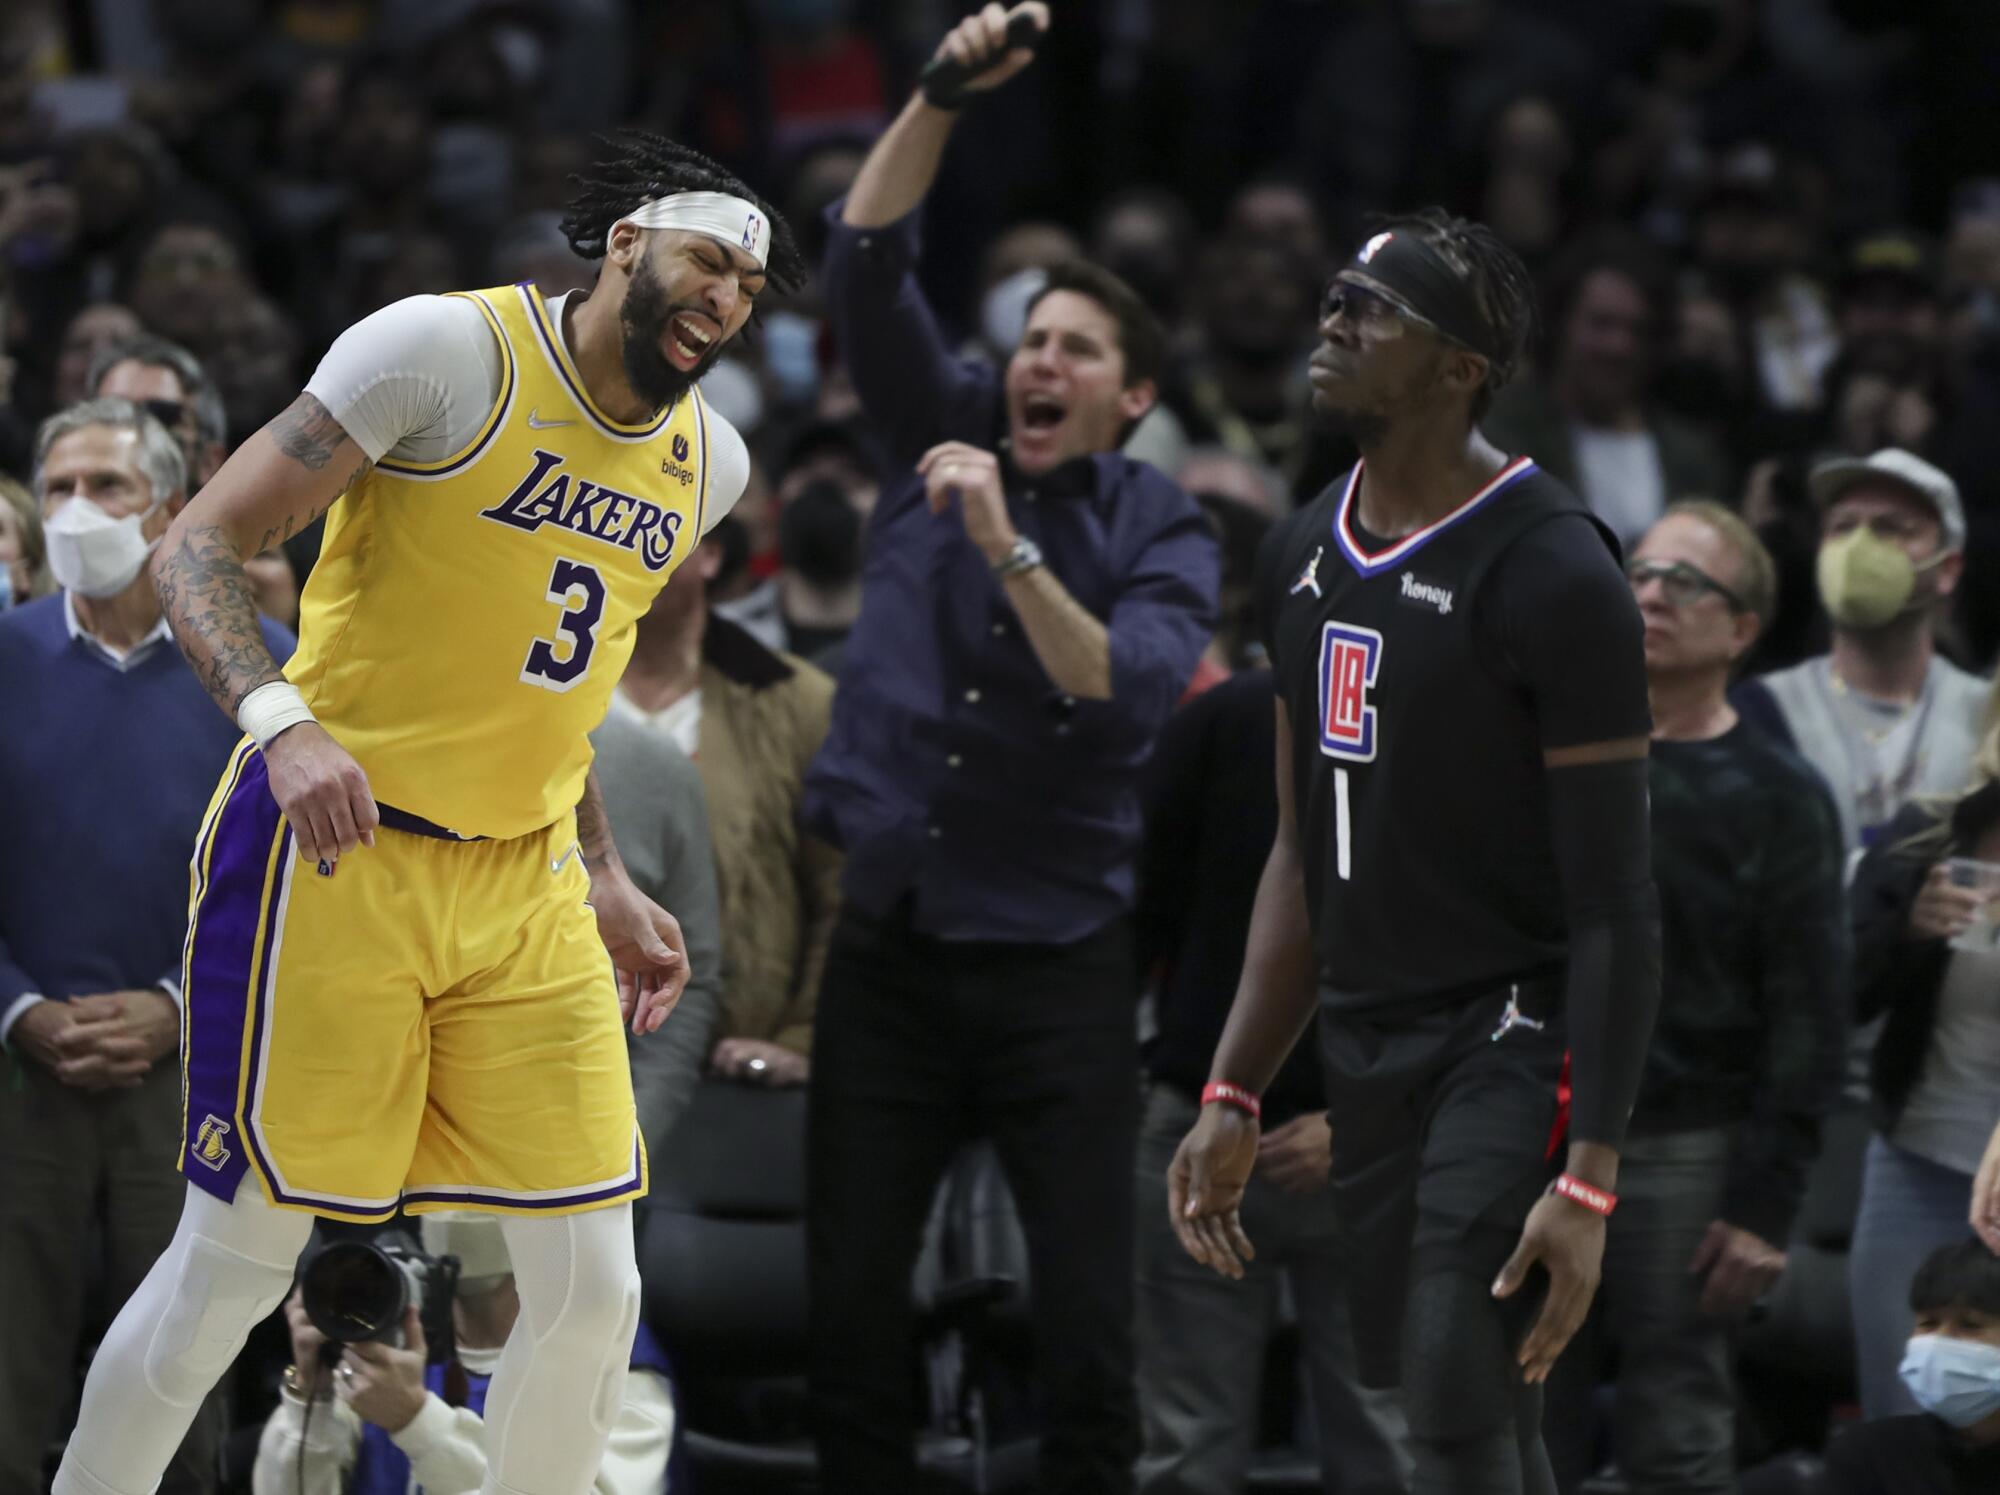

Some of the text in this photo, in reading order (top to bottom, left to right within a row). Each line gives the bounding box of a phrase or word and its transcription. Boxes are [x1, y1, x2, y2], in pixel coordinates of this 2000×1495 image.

[478, 448, 683, 571] LAKERS
[661, 459, 694, 486] bibigo
[519, 555, 608, 694] 3
[1401, 572, 1452, 614] honey
[1334, 767, 1351, 881] 1
